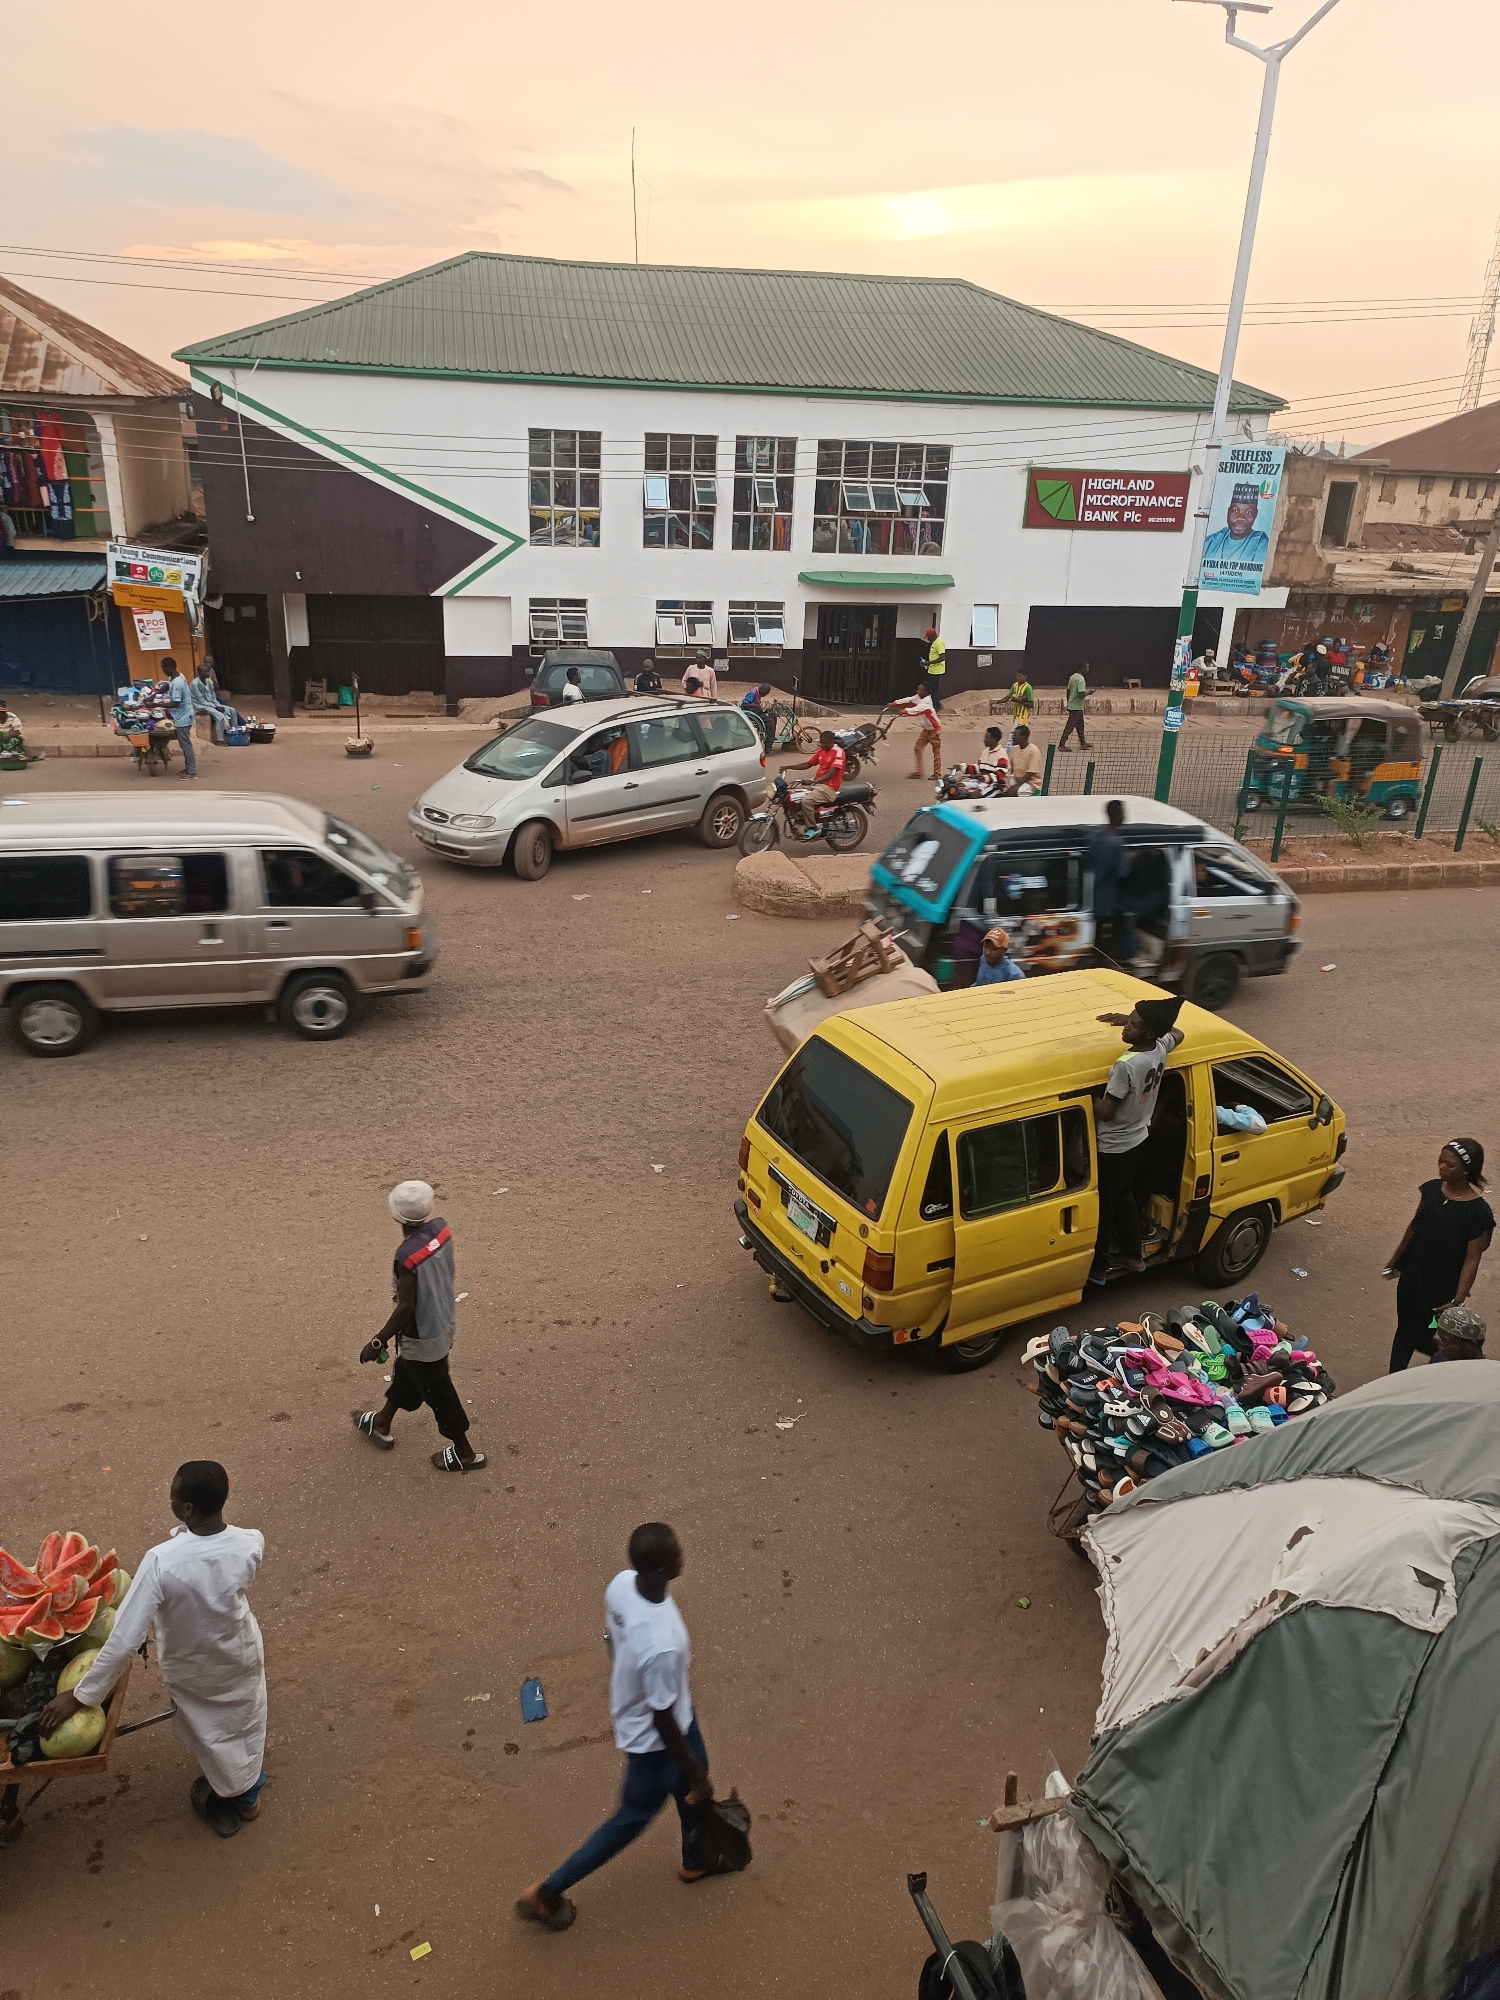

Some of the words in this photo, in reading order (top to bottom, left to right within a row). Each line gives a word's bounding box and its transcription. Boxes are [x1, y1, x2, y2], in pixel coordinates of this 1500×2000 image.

[1230, 449, 1273, 463] SELFLESS
[1218, 461, 1256, 474] SERVICE
[1256, 463, 1281, 476] 2027
[1087, 478, 1155, 491] HIGHLAND
[1085, 494, 1184, 508] MICROFINANCE
[1084, 510, 1119, 522] BANK
[1123, 511, 1142, 523] Plc
[141, 551, 197, 566] Communications
[150, 570, 163, 579] glo
[146, 618, 165, 626] POS
[788, 1185, 810, 1208] TOYOTA
